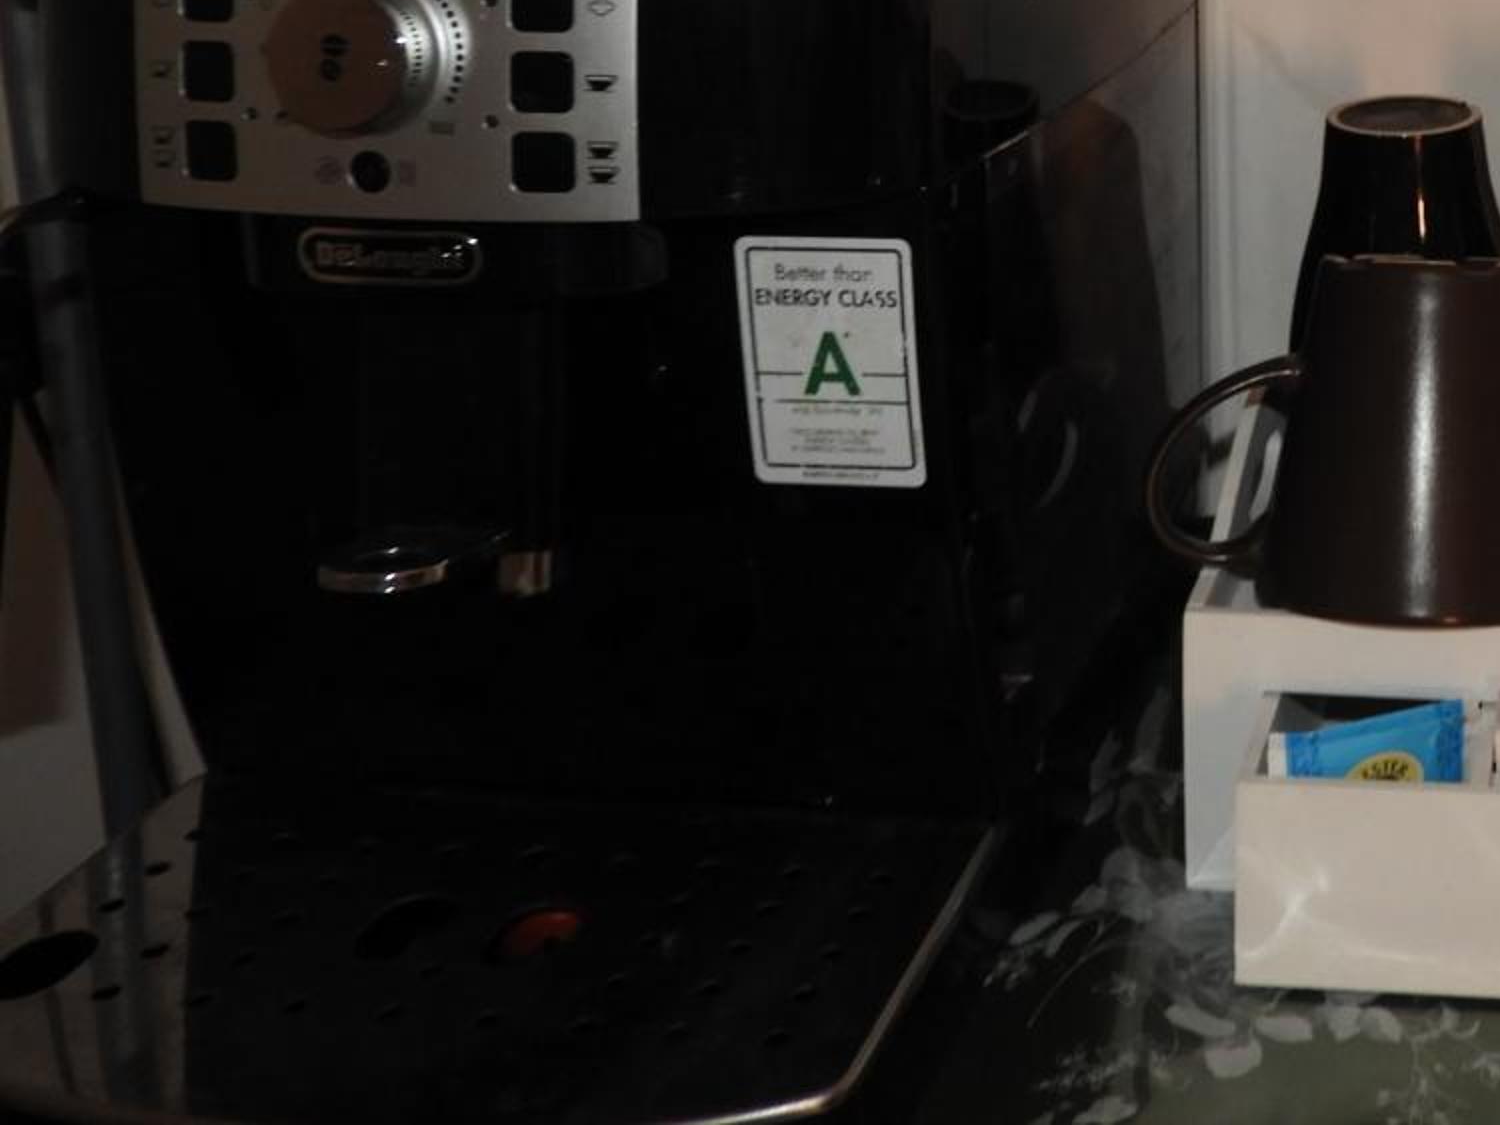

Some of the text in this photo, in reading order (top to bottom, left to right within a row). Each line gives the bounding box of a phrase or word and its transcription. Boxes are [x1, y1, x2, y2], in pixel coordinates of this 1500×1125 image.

[773, 261, 874, 282] Better than
[754, 287, 898, 309] ENERGY CLASS
